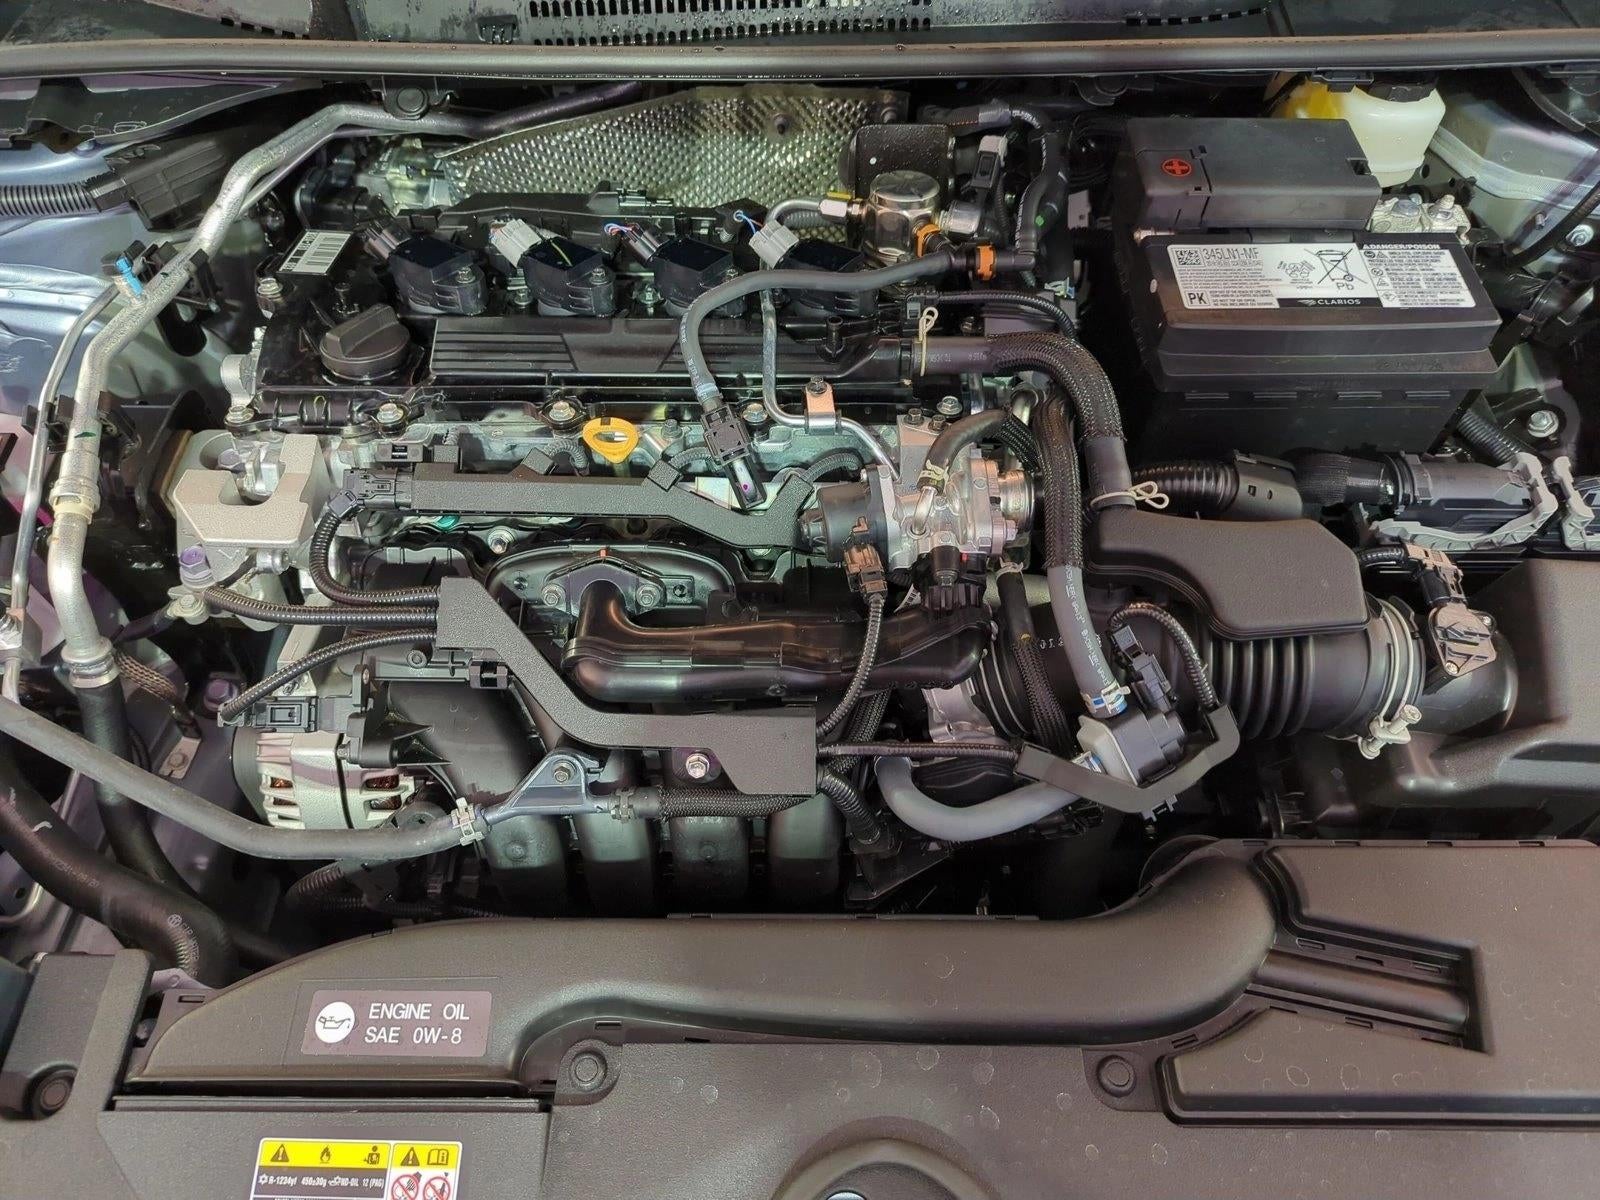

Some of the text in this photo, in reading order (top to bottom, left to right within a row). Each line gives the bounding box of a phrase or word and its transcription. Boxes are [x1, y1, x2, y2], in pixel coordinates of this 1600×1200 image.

[1336, 282, 1355, 291] Pb
[1187, 292, 1208, 306] PK
[368, 1002, 470, 1021] ENGINE OIL
[364, 1026, 462, 1044] SAE 0W-8
[268, 1175, 297, 1187] R-1234yf
[362, 1178, 369, 1187] 12
